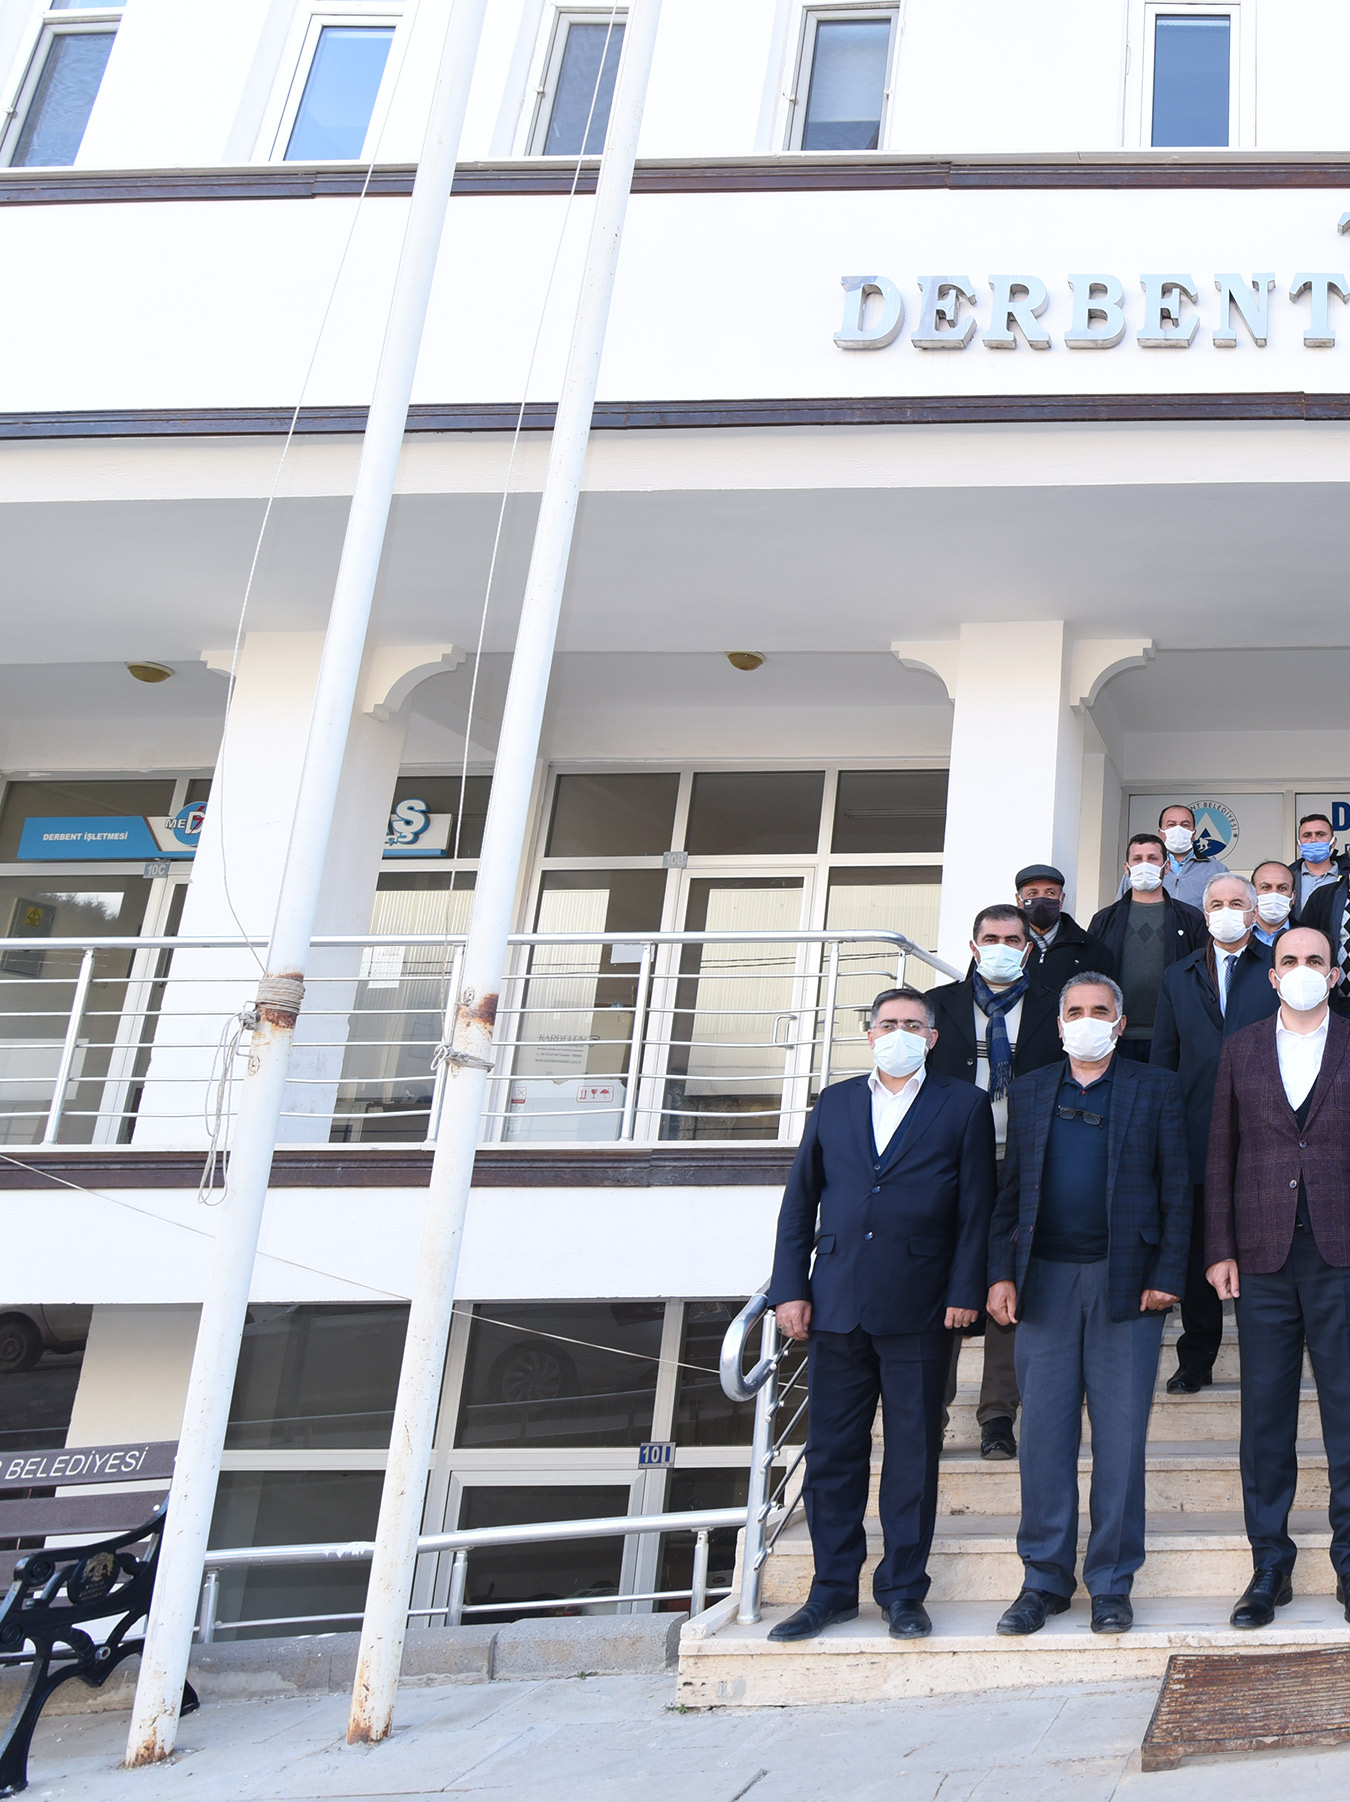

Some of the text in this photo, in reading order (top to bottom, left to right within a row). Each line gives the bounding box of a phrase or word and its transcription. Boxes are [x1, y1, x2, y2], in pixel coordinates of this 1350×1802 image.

[833, 273, 1350, 350] DERBENT
[42, 831, 129, 842] DERBENT İŞLETMESİ
[147, 864, 167, 876] 10C
[4, 1446, 149, 1480] BELEDİYESİ
